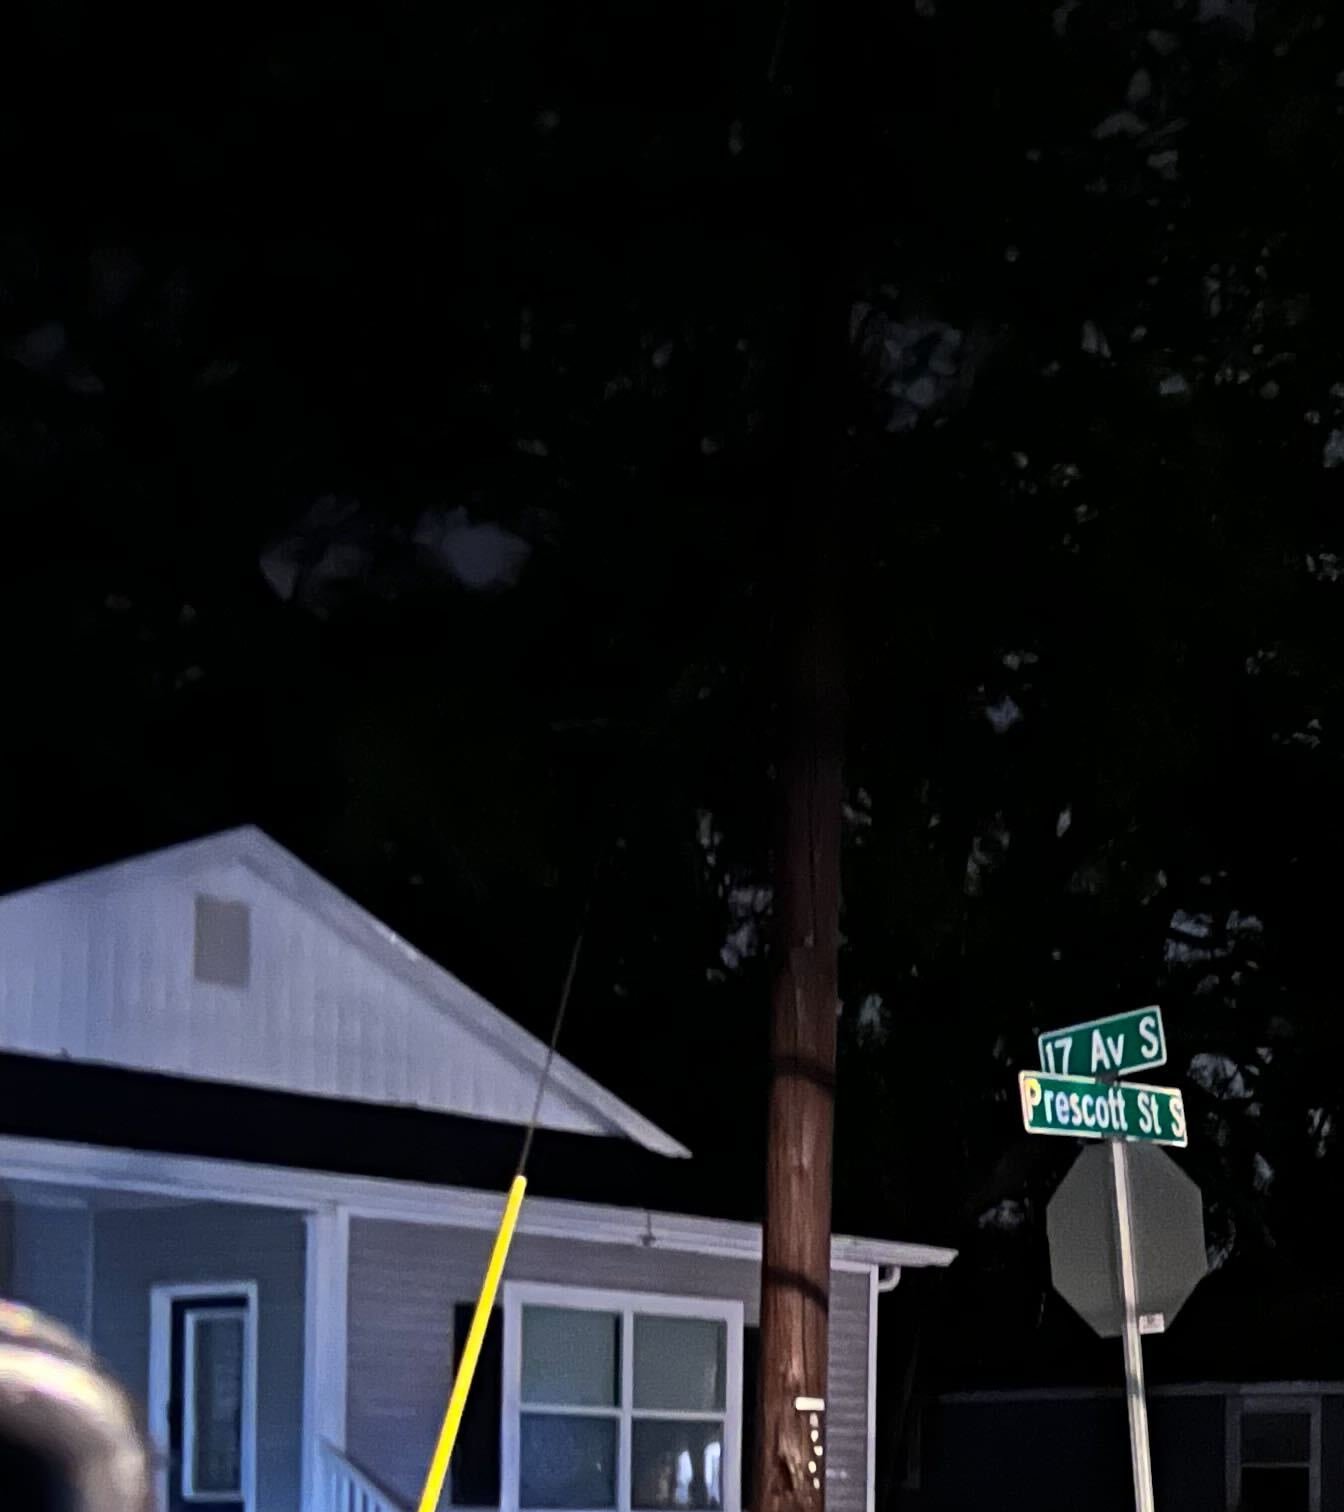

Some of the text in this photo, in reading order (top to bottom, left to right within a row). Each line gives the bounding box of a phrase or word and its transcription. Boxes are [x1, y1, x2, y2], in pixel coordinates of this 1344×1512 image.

[1045, 1015, 1160, 1075] 17 Av S
[1023, 1078, 1186, 1138] Prescott St S
